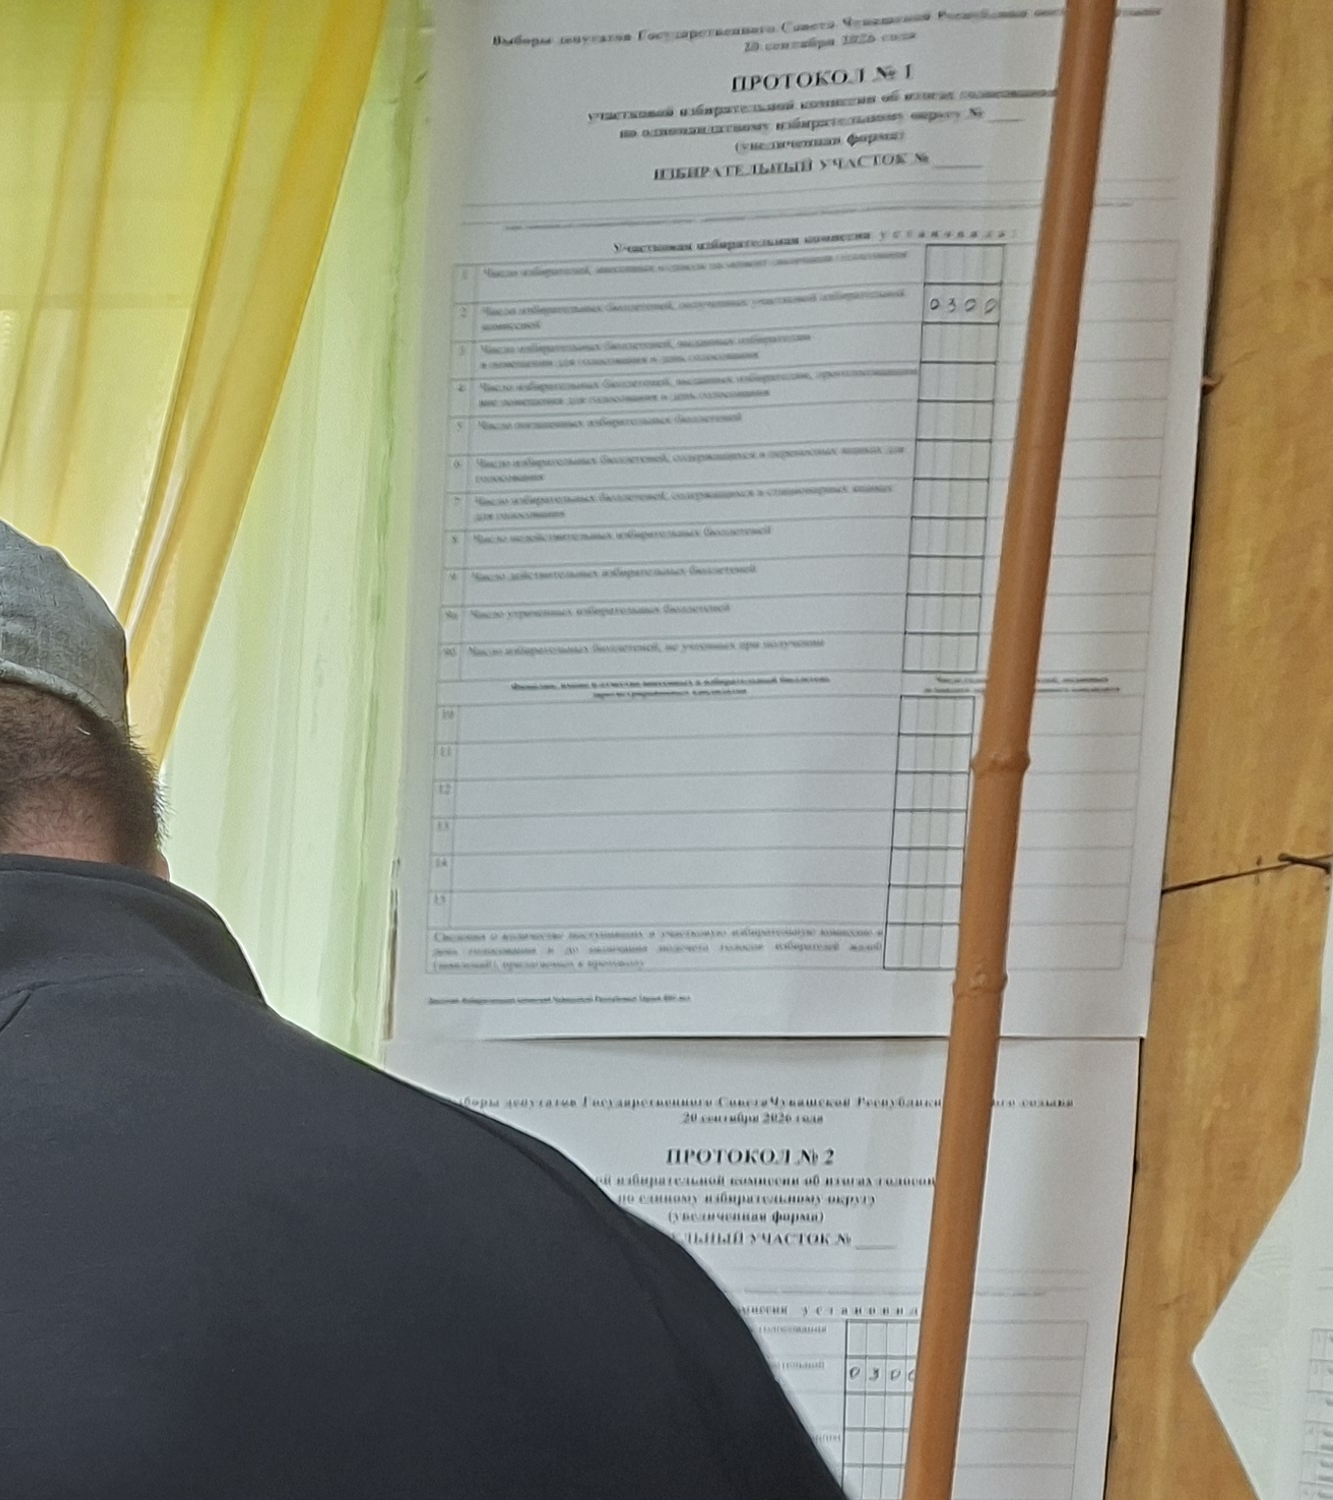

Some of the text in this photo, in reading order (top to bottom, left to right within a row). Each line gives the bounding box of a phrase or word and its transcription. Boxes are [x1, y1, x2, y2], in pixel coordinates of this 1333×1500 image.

[731, 63, 912, 92] ПРОТОКОЛ № 1
[654, 158, 813, 181] ИЗБИРАТЕЛЬНЫЙ
[819, 154, 907, 171] УЧАСТОК
[665, 1148, 835, 1166] ПРОТОКОЛ № 2
[750, 1232, 830, 1246] УЧАСТОК
